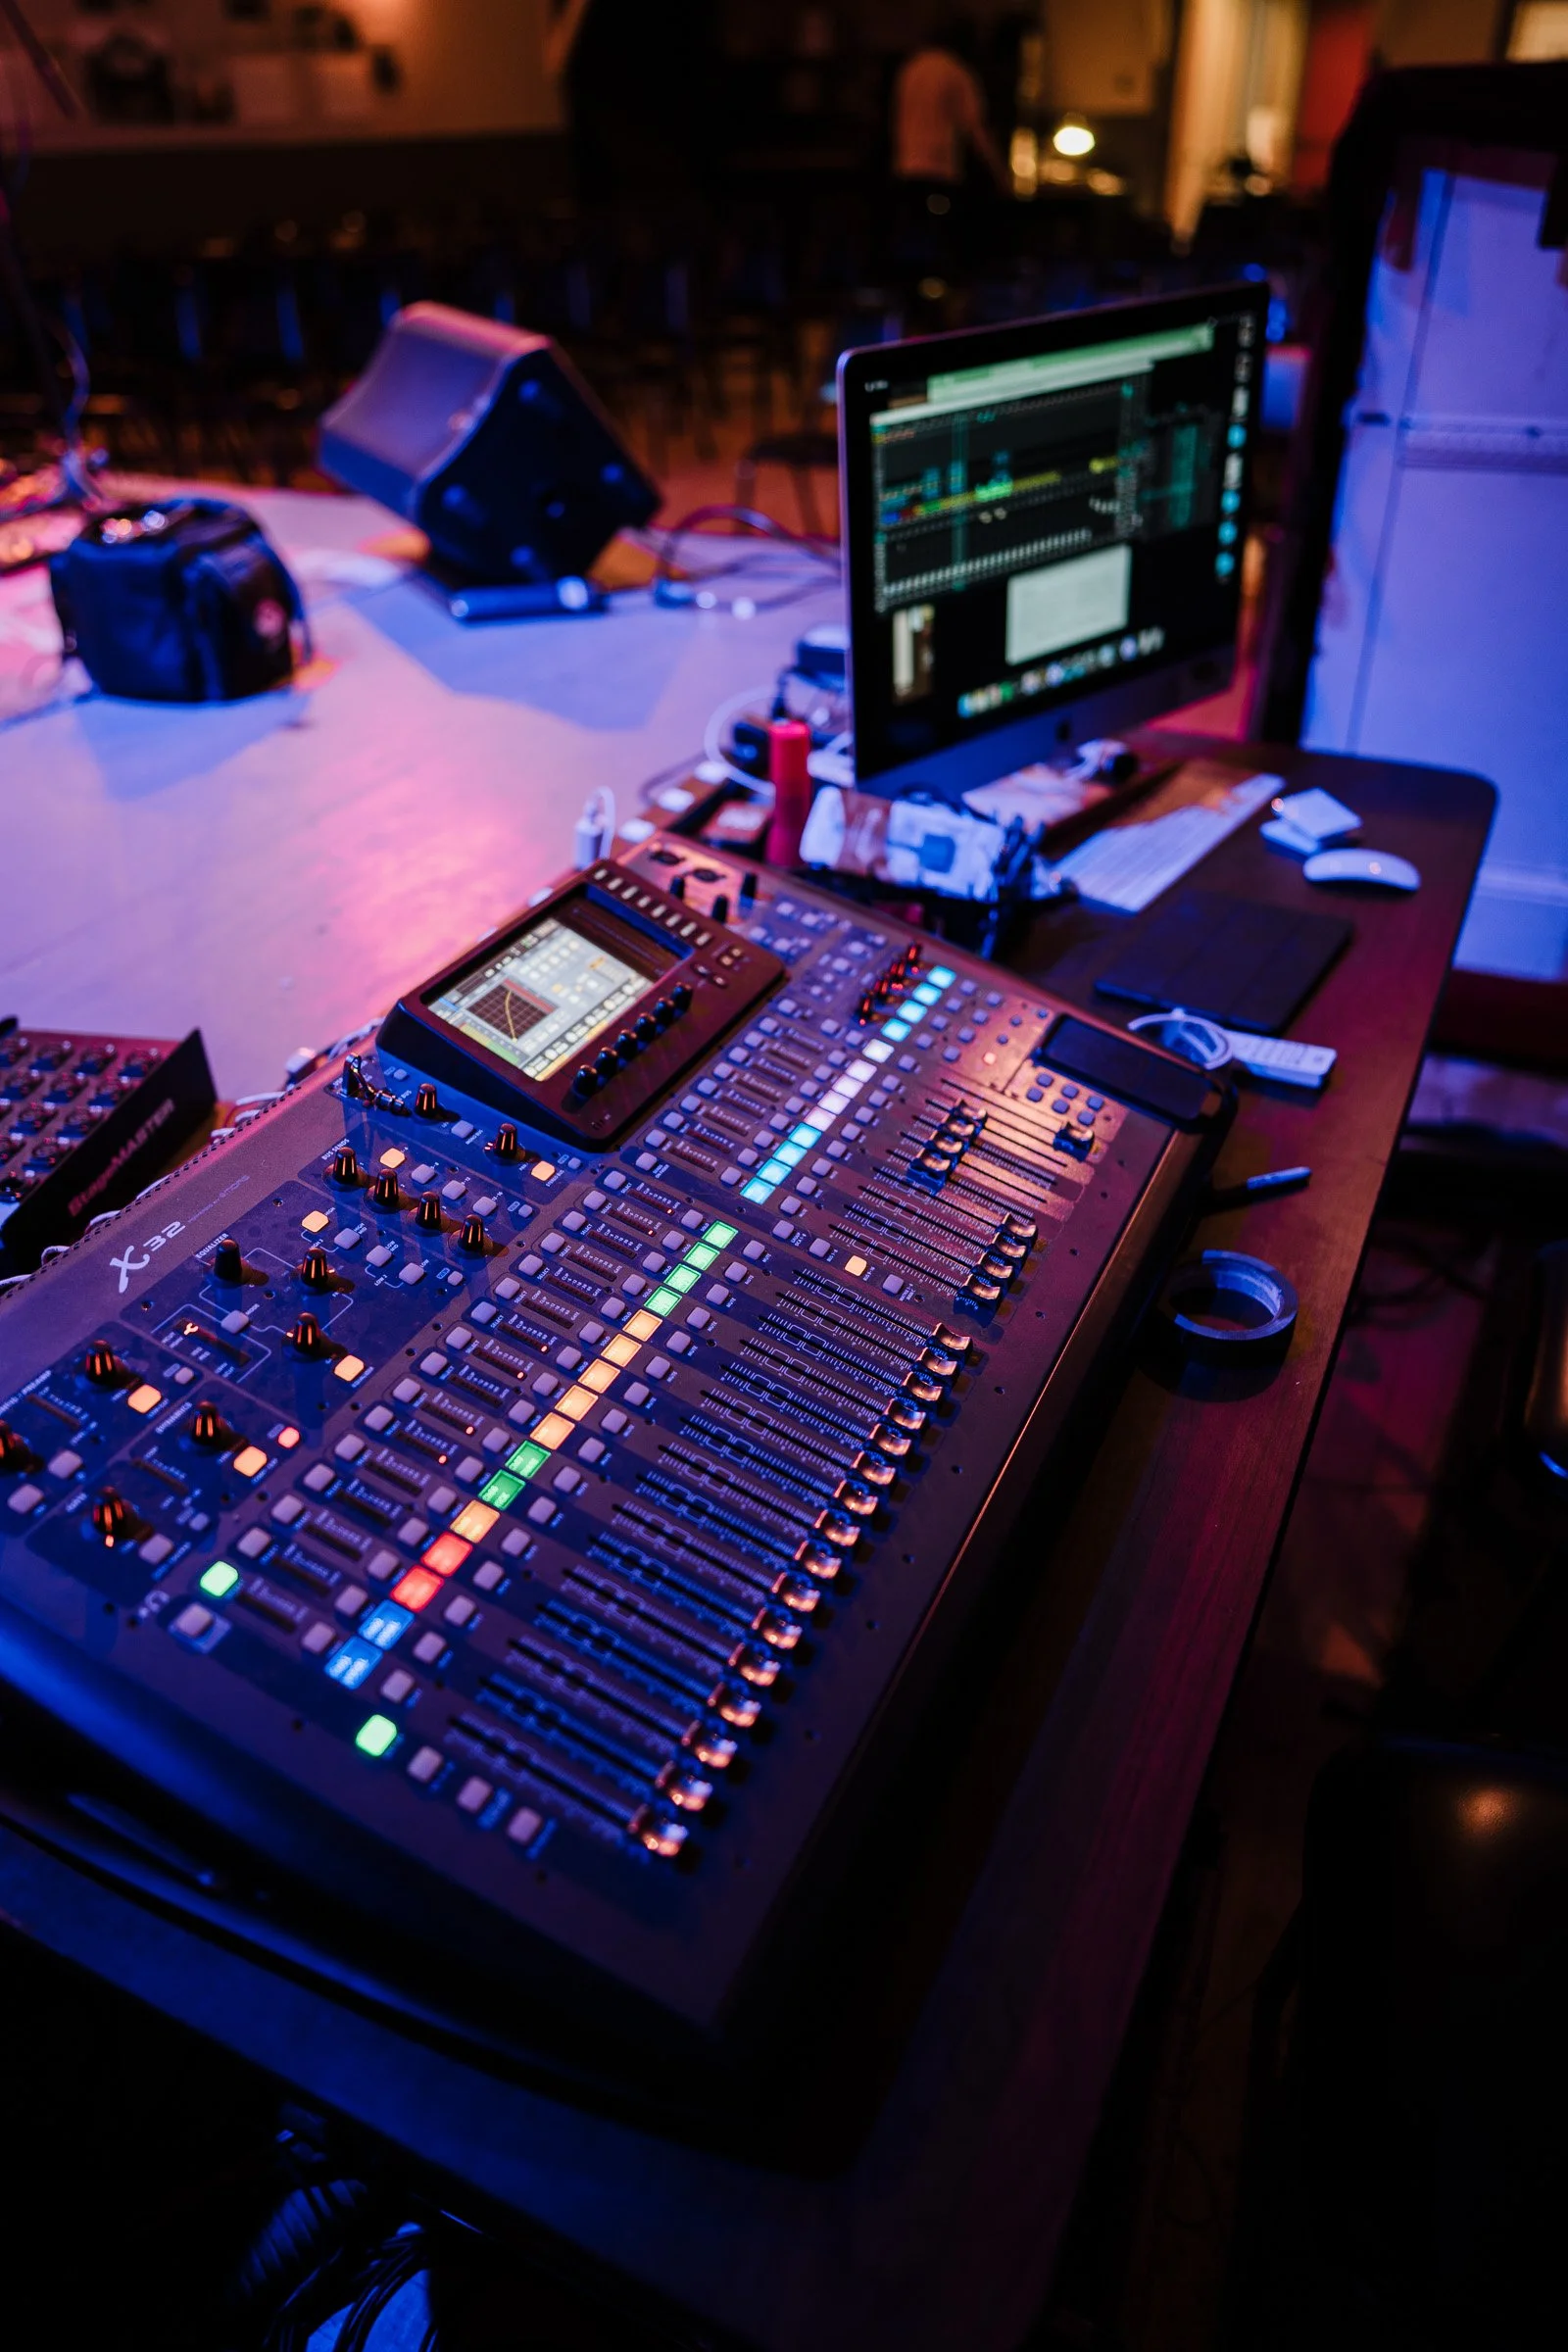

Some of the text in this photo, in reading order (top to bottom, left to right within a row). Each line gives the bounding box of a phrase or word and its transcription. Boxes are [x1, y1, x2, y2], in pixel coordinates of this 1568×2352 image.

[321, 1150, 333, 1160] BUS
[580, 1224, 593, 1235] SELECT
[195, 1233, 228, 1259] EQUALIZER
[560, 1246, 571, 1257] SELECT
[537, 1267, 550, 1280] SELECT
[662, 1265, 672, 1275] SOLO
[514, 1291, 527, 1303] SELECT
[643, 1288, 653, 1298] SOLO
[490, 1315, 505, 1329] SELECT
[622, 1311, 632, 1322] SOLO
[601, 1336, 611, 1347] SOLO
